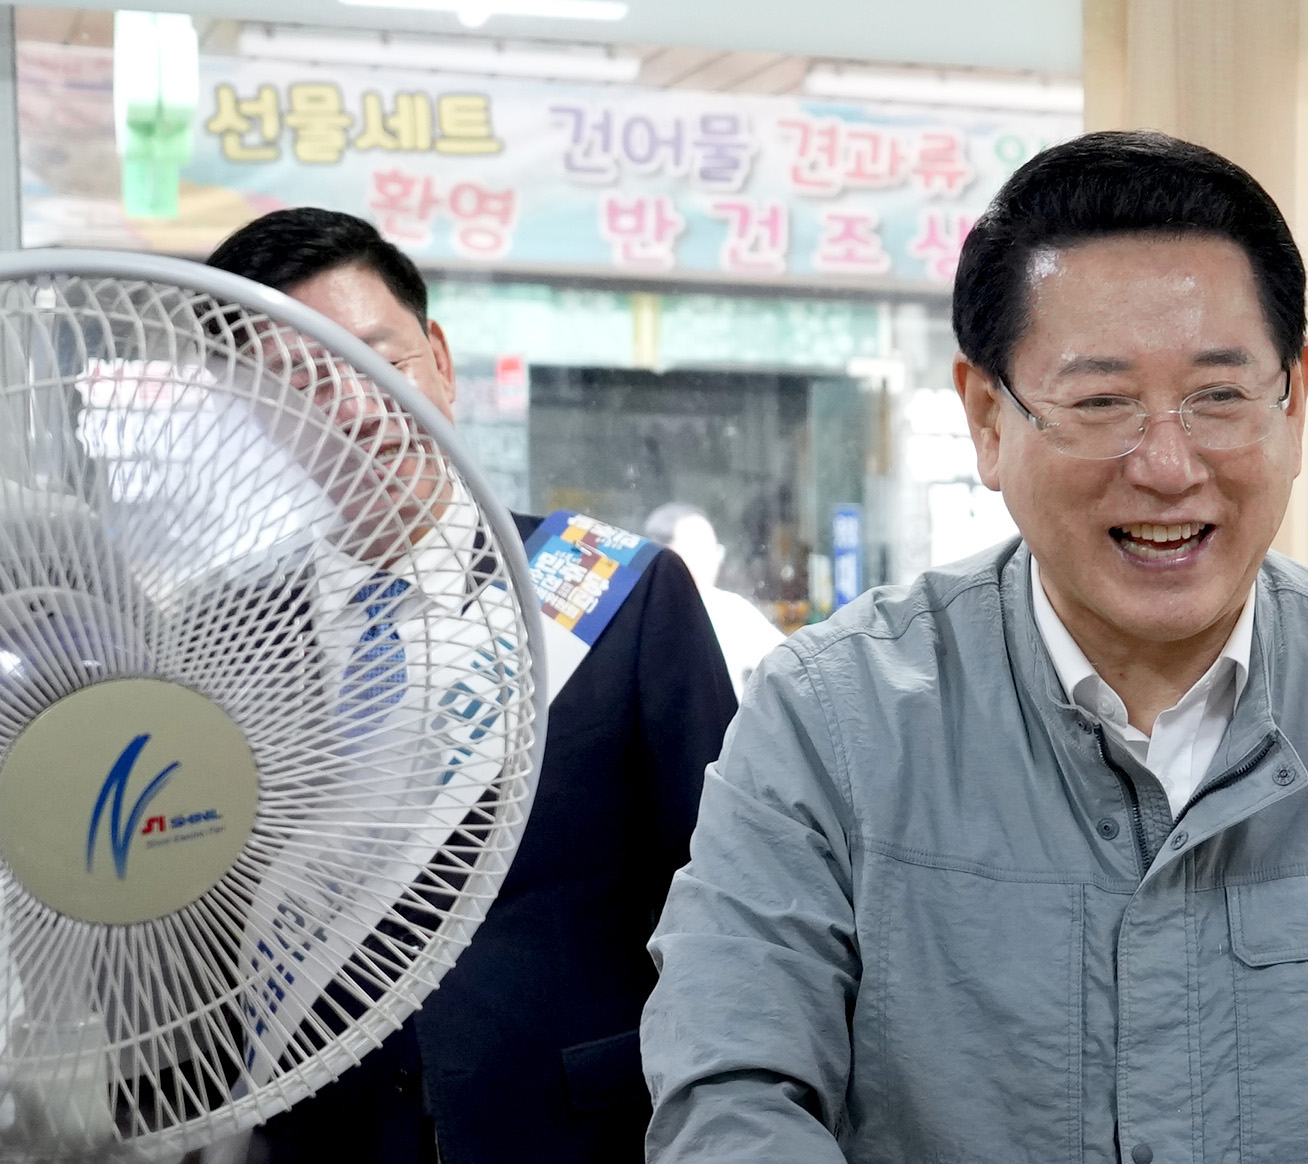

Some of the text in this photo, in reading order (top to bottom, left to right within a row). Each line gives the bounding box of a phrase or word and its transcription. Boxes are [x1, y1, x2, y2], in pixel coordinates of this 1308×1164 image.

[207, 84, 503, 163] 선물세트
[549, 106, 748, 184] 건어물
[777, 118, 970, 189] 견과류
[370, 170, 515, 252] 환영
